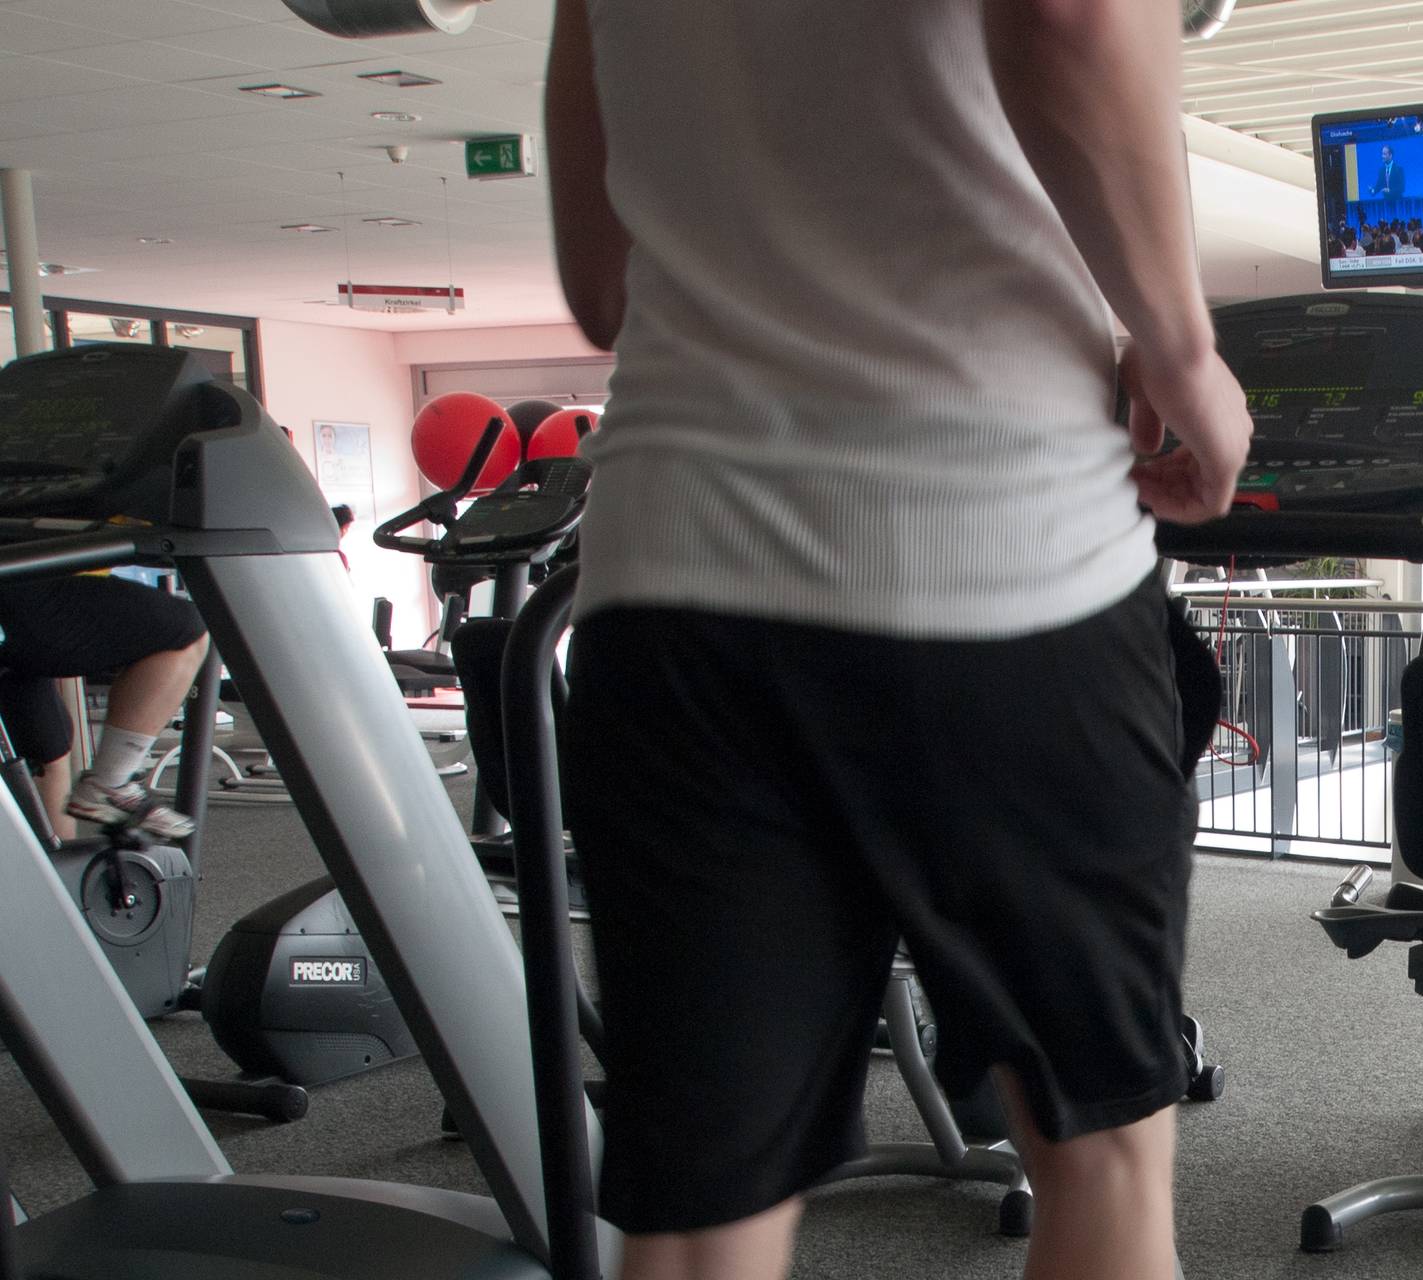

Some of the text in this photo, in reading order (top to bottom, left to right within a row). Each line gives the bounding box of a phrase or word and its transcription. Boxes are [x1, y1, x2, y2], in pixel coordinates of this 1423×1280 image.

[384, 298, 422, 306] Kraftzirkel
[293, 961, 361, 981] PRECOR USA
